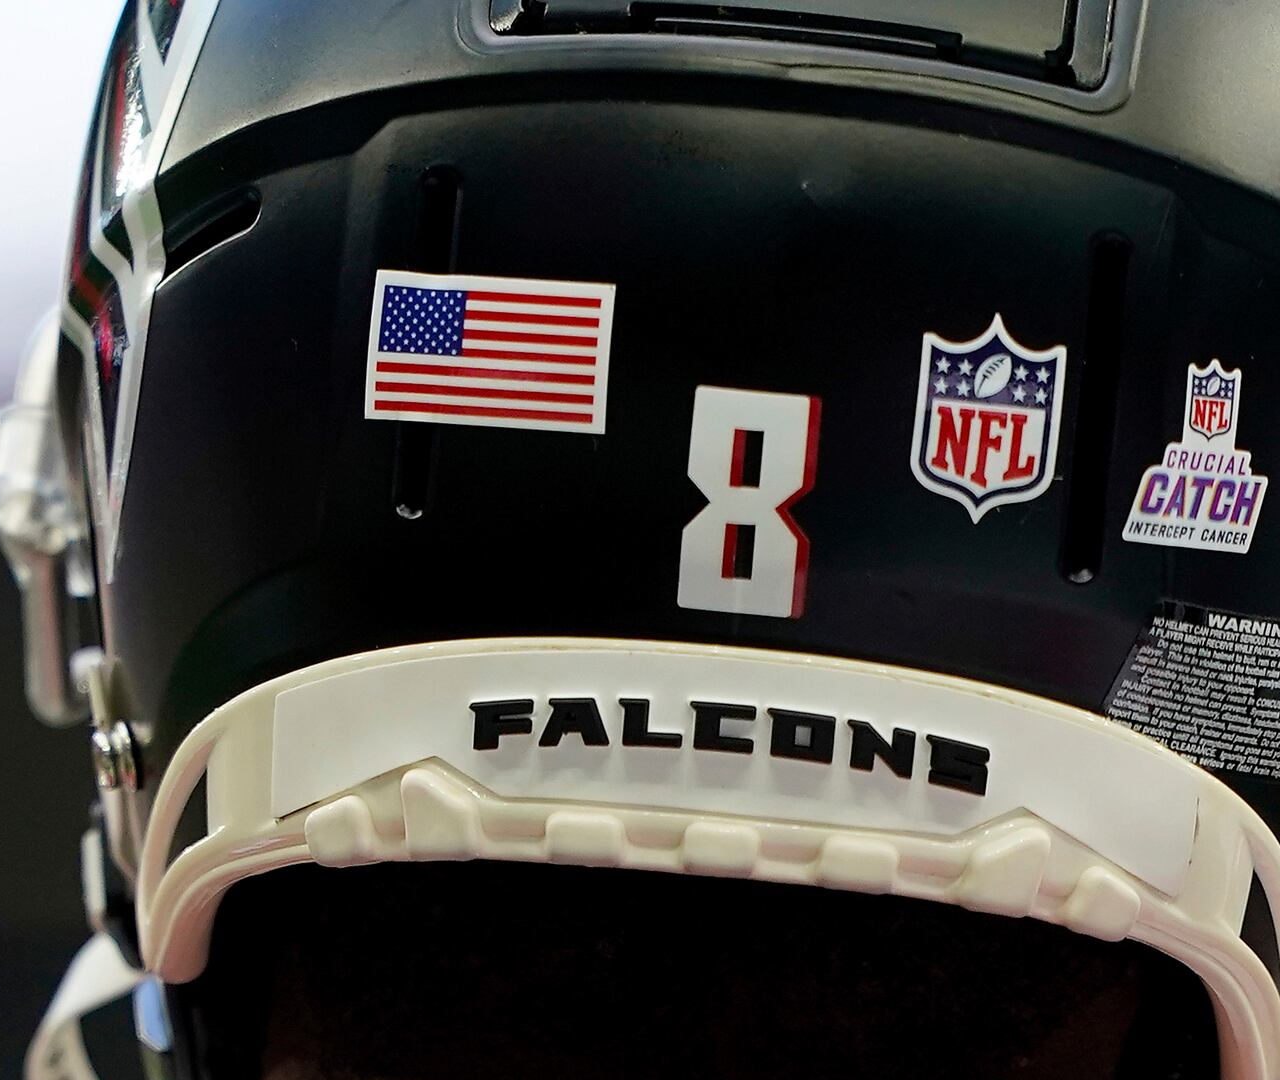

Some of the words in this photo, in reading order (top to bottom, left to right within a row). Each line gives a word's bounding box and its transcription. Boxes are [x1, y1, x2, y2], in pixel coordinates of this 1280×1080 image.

[1193, 399, 1228, 433] NFL
[931, 406, 1035, 489] NFL
[1167, 450, 1246, 475] CRUCIAL
[677, 385, 820, 618] 8
[1140, 473, 1261, 526] CATCH
[1129, 521, 1195, 540] INTERCEPT
[1201, 529, 1248, 546] CANCER
[469, 698, 990, 796] FALCONS
